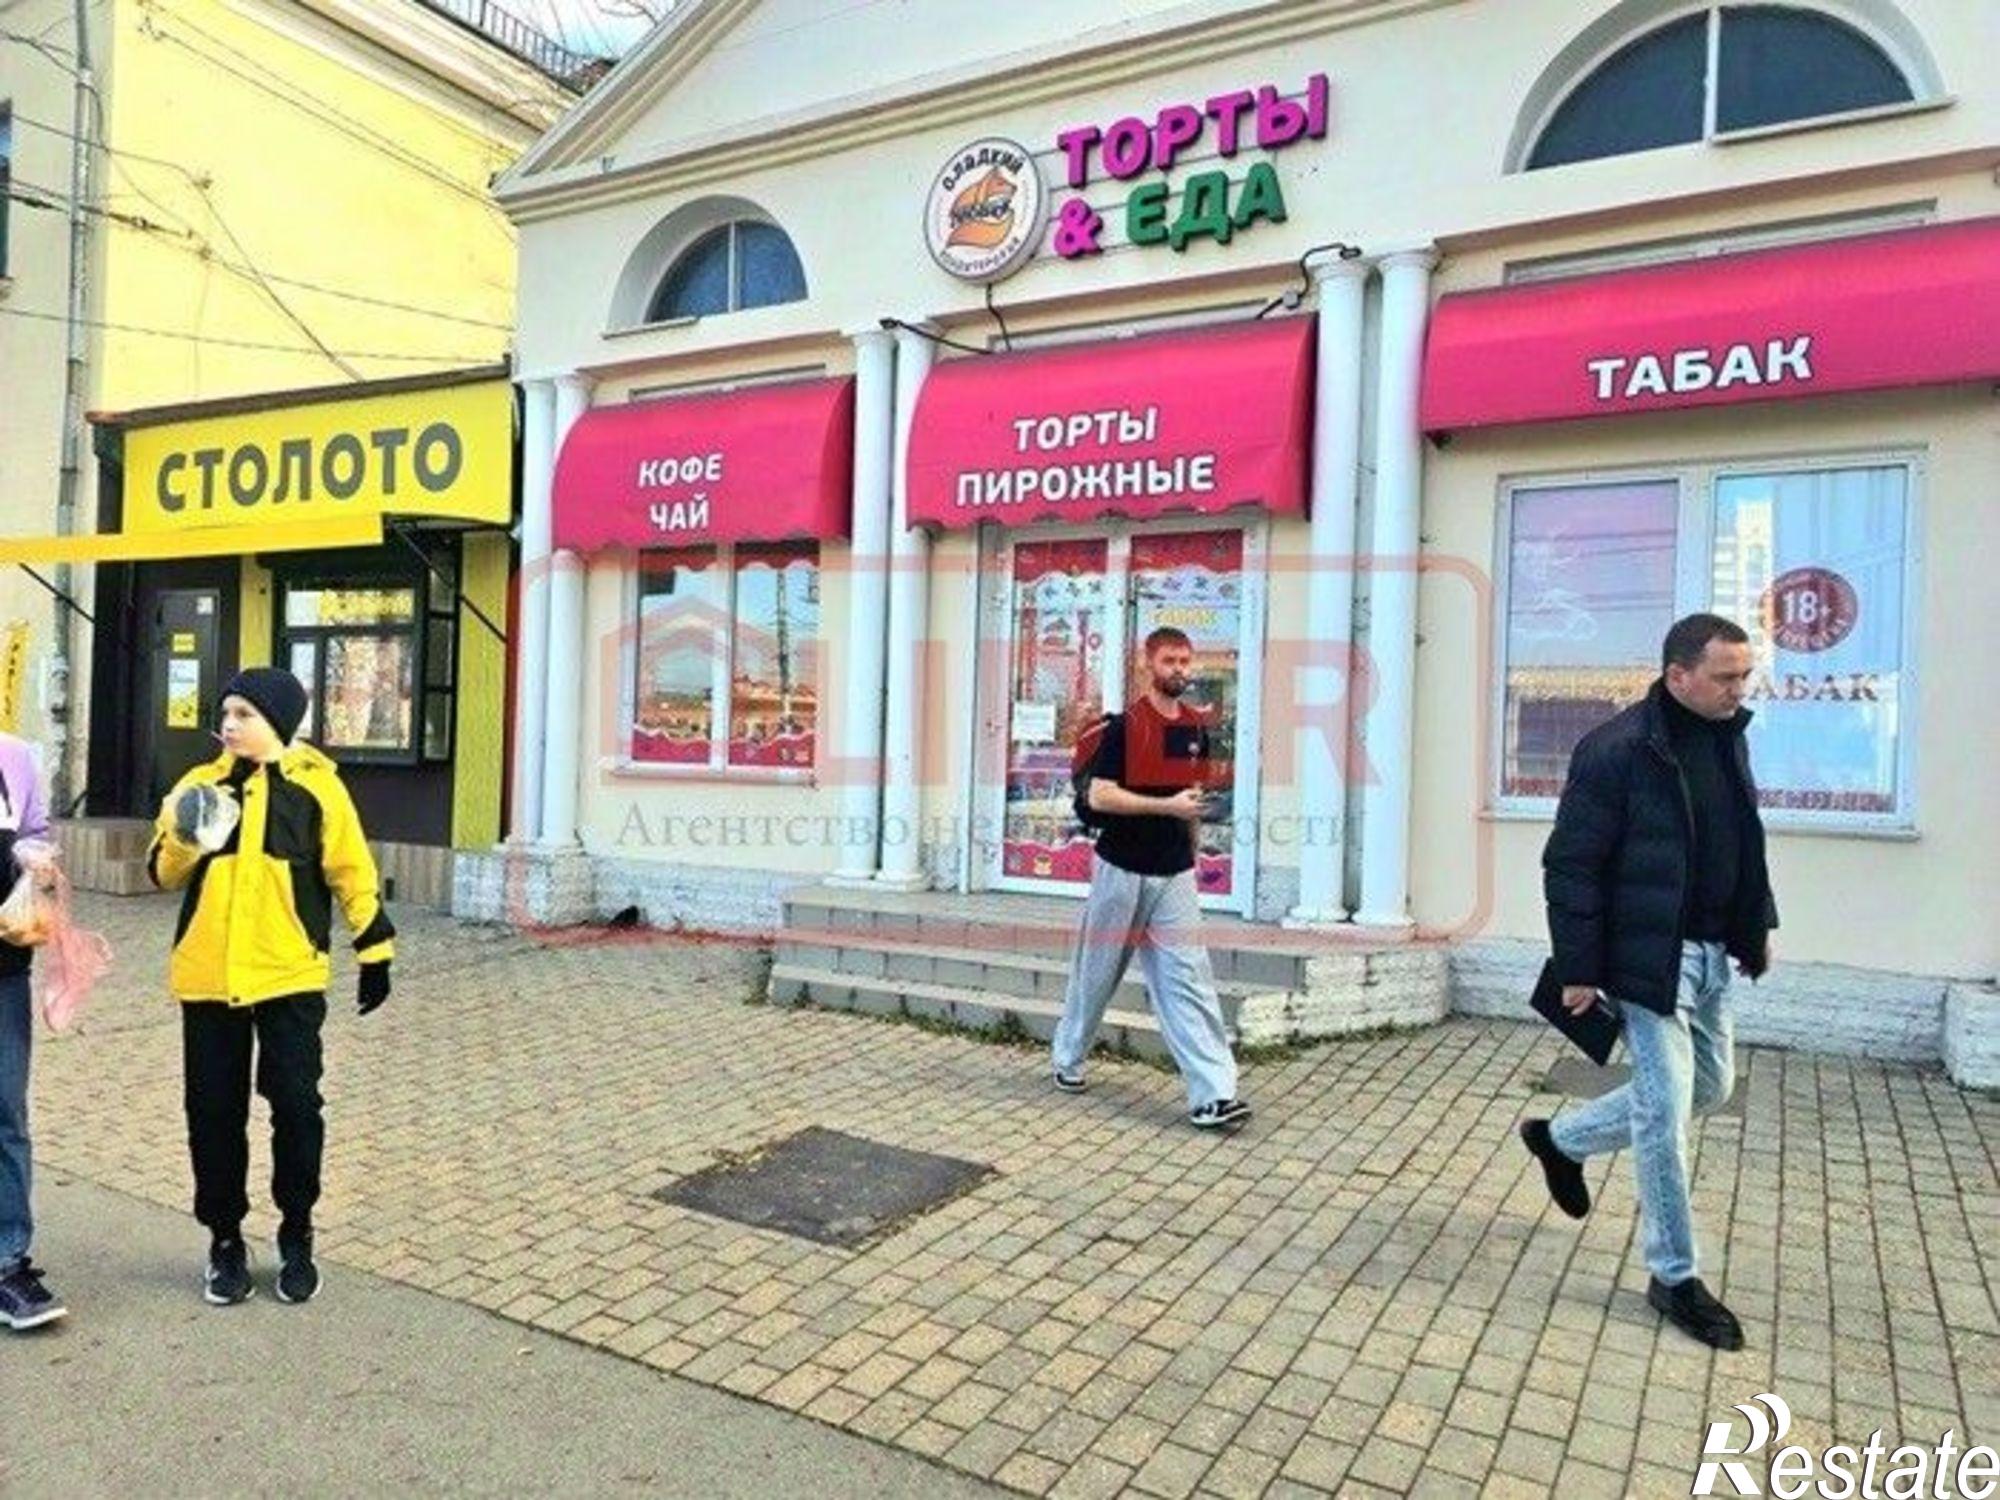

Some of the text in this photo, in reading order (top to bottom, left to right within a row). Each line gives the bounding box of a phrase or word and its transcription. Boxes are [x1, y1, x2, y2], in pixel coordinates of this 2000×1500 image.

[1057, 73, 1329, 188] ТОРТЫ
[1053, 198, 1104, 259] &
[1125, 162, 1287, 252] ЕДА
[1587, 336, 1813, 399] ТАБАК
[1013, 406, 1158, 453] ТОРТЫ
[157, 422, 463, 512] СТОЛОТО
[638, 452, 723, 488] КОФЕ
[956, 453, 1216, 506] ПИРОЖНЫЕ
[650, 493, 710, 531] ЧАЙ
[1783, 591, 1831, 624] 18+
[1748, 672, 1879, 701] АБАК
